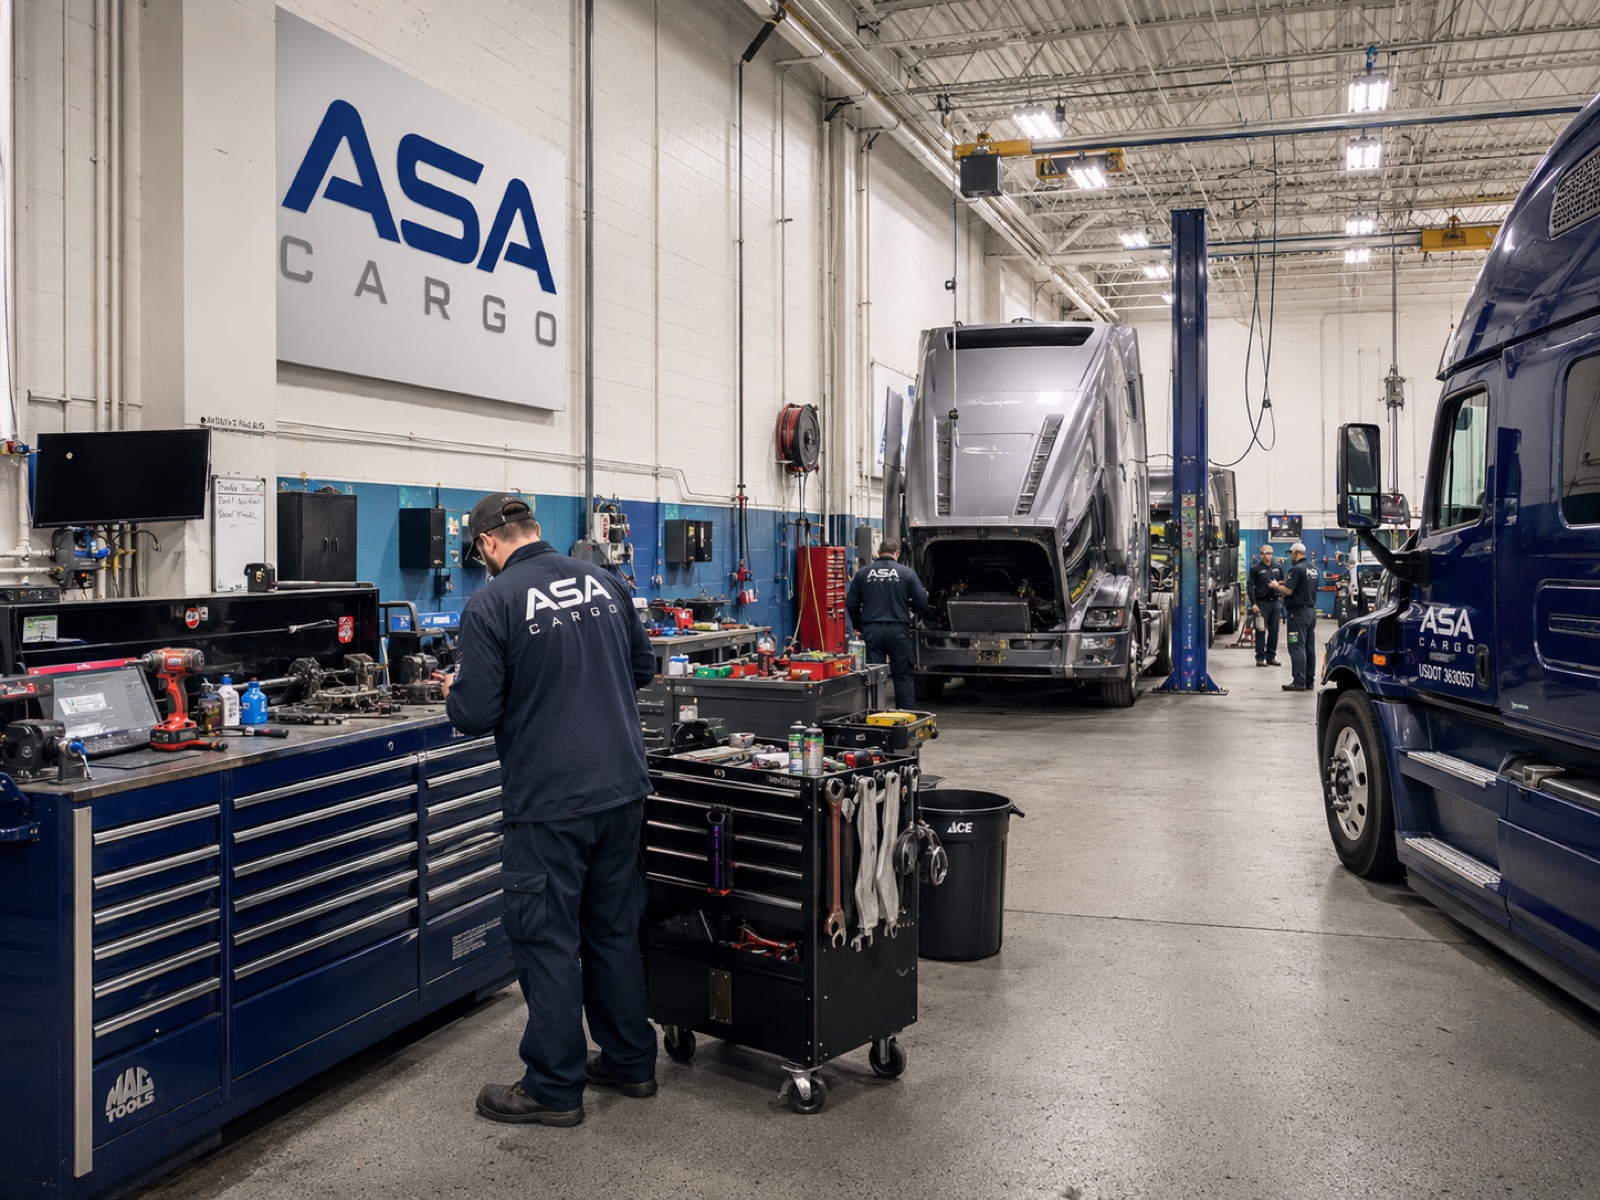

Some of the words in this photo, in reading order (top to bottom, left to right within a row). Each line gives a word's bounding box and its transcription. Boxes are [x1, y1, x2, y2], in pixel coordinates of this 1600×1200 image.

[282, 99, 557, 295] ASA
[280, 234, 557, 347] CARGO
[867, 568, 899, 578] ASA
[525, 574, 613, 621] ASA
[528, 603, 617, 635] CARGO
[1420, 606, 1475, 640] ASA
[1418, 636, 1475, 654] CARGO
[1418, 663, 1442, 681] USDOT
[946, 821, 973, 833] ACE
[105, 1090, 155, 1123] TOOLS
